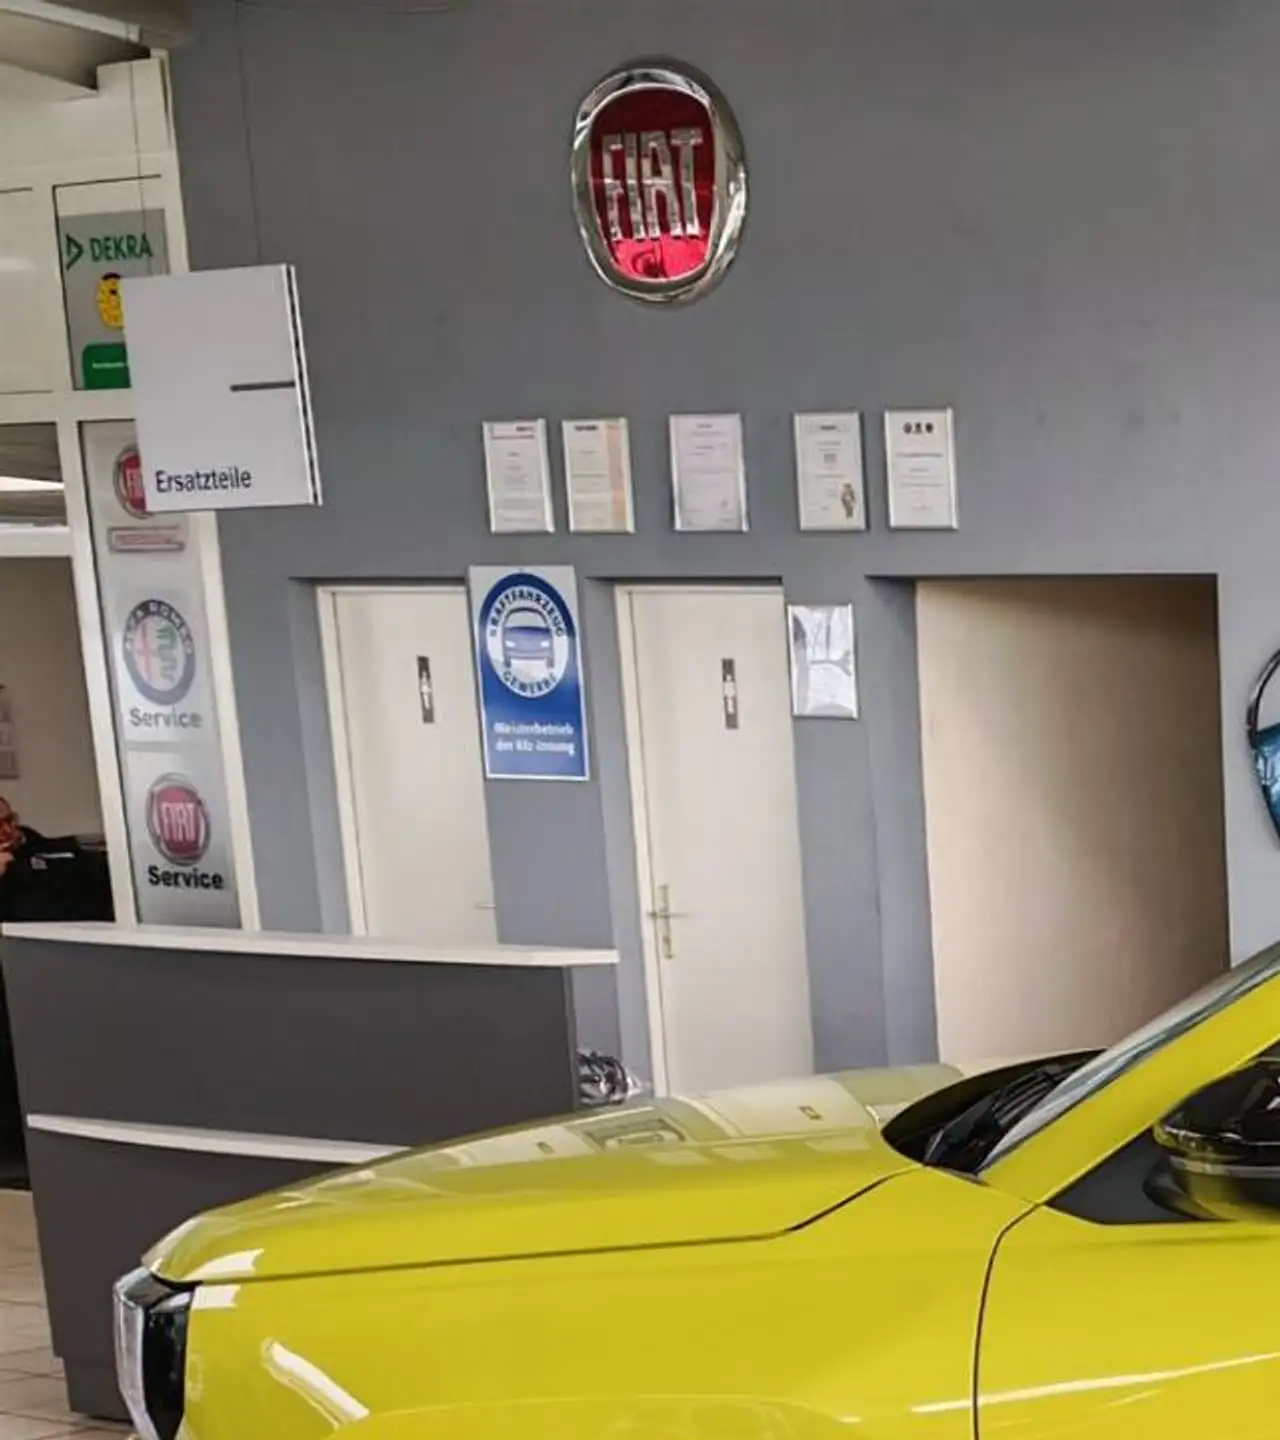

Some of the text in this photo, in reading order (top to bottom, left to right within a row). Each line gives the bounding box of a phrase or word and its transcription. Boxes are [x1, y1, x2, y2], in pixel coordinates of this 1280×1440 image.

[602, 127, 703, 242] FIAT
[88, 233, 154, 263] DEKRA
[155, 466, 253, 493] Ersatzteile
[129, 706, 203, 730] Service
[147, 865, 224, 890] Service
